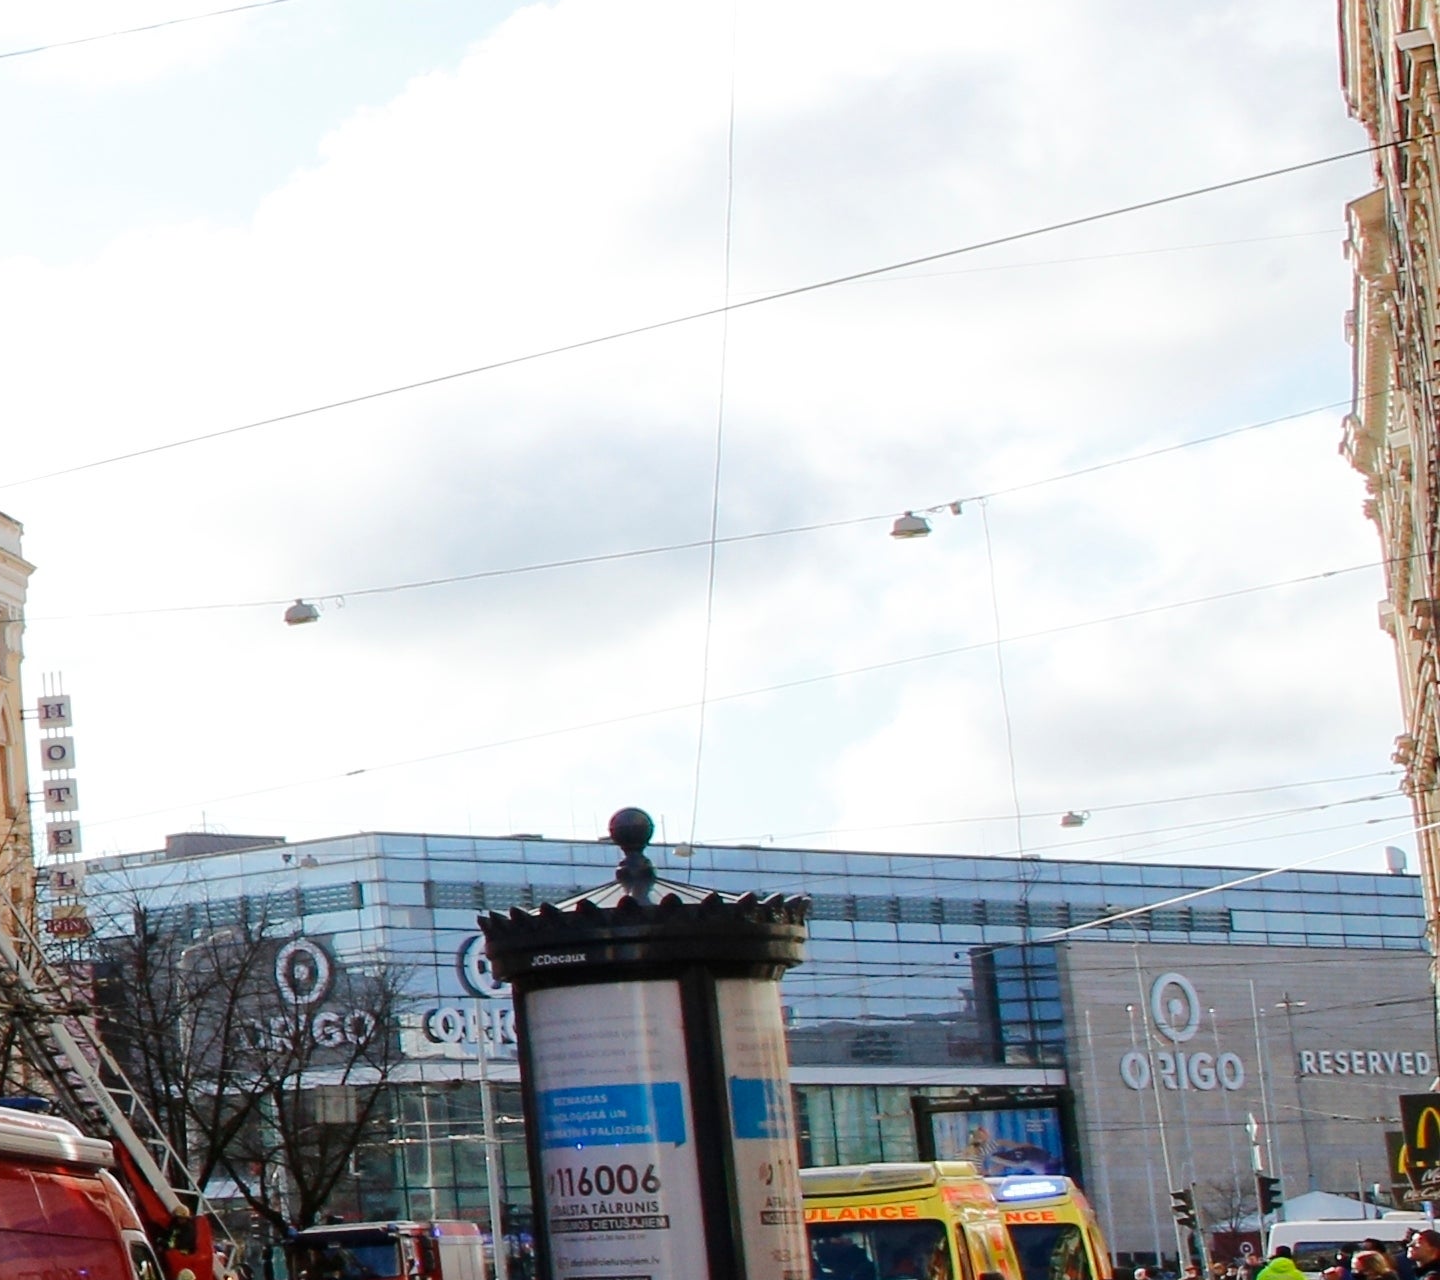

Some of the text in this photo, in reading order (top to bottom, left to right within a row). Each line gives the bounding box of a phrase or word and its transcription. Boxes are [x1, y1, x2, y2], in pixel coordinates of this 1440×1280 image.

[42, 703, 76, 888] HOTEL
[531, 953, 587, 966] JCDecaux
[1120, 1051, 1245, 1091] ORIGO
[1299, 1050, 1431, 1075] RESERVED
[557, 1164, 662, 1197] 116006
[592, 1200, 659, 1214] TĀLRUNIS
[804, 1205, 919, 1220] ULANCE
